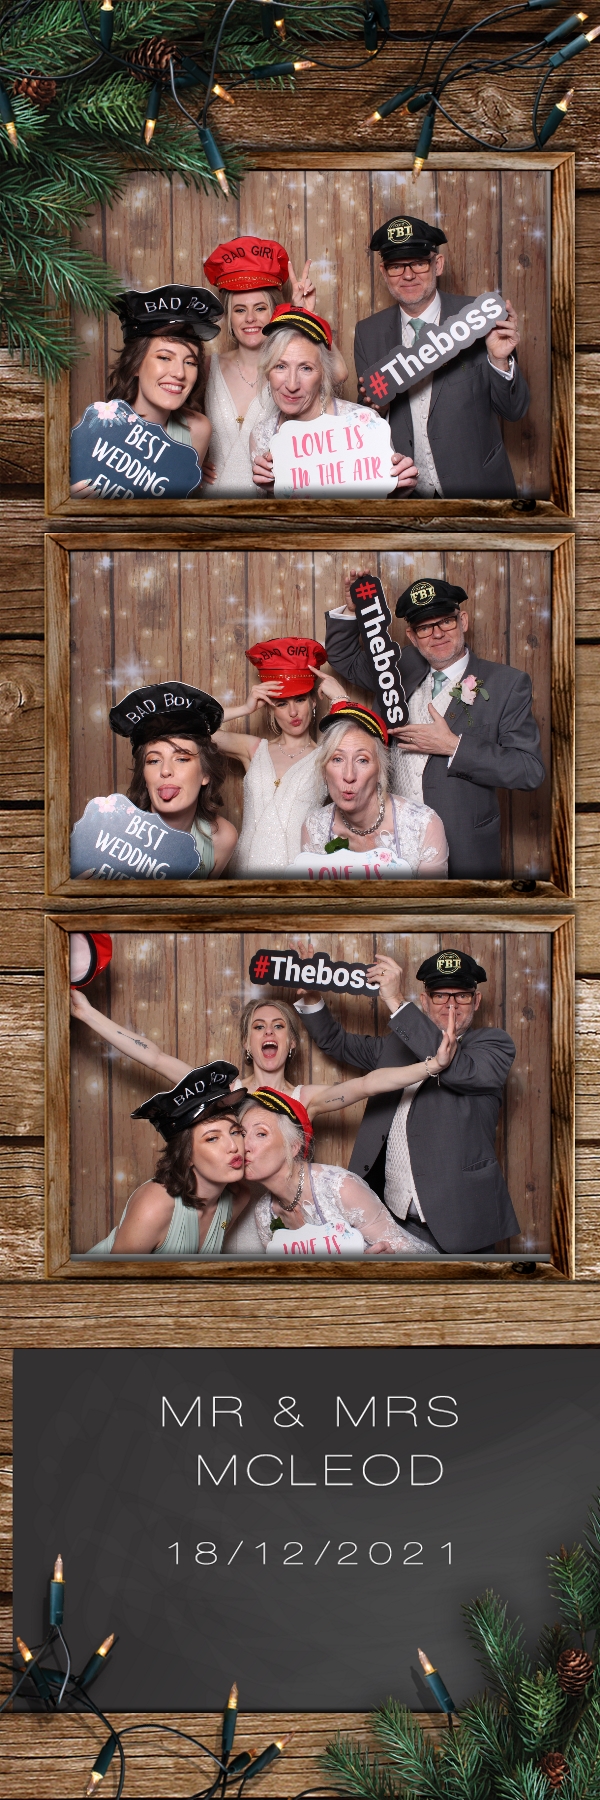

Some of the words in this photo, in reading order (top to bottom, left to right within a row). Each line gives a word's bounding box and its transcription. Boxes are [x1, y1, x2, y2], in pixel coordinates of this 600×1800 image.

[388, 226, 411, 238] FBI
[222, 247, 245, 263] BAD
[251, 246, 274, 260] GIRL
[144, 298, 181, 313] BAD
[369, 298, 502, 399] #Theboss
[125, 423, 170, 463] BEST
[292, 429, 337, 458] LOVE
[343, 424, 364, 450] IS
[91, 437, 170, 497] WEDDING
[316, 461, 346, 486] THE
[353, 456, 383, 481] AIR
[411, 587, 434, 602] FBI
[260, 648, 282, 660] BAD
[287, 646, 309, 657] GIRL
[355, 581, 404, 724] #Theboss
[126, 699, 156, 724] BAD
[125, 815, 168, 850] BEST
[95, 830, 171, 880] WEDDING
[173, 1080, 205, 1106] BAD
